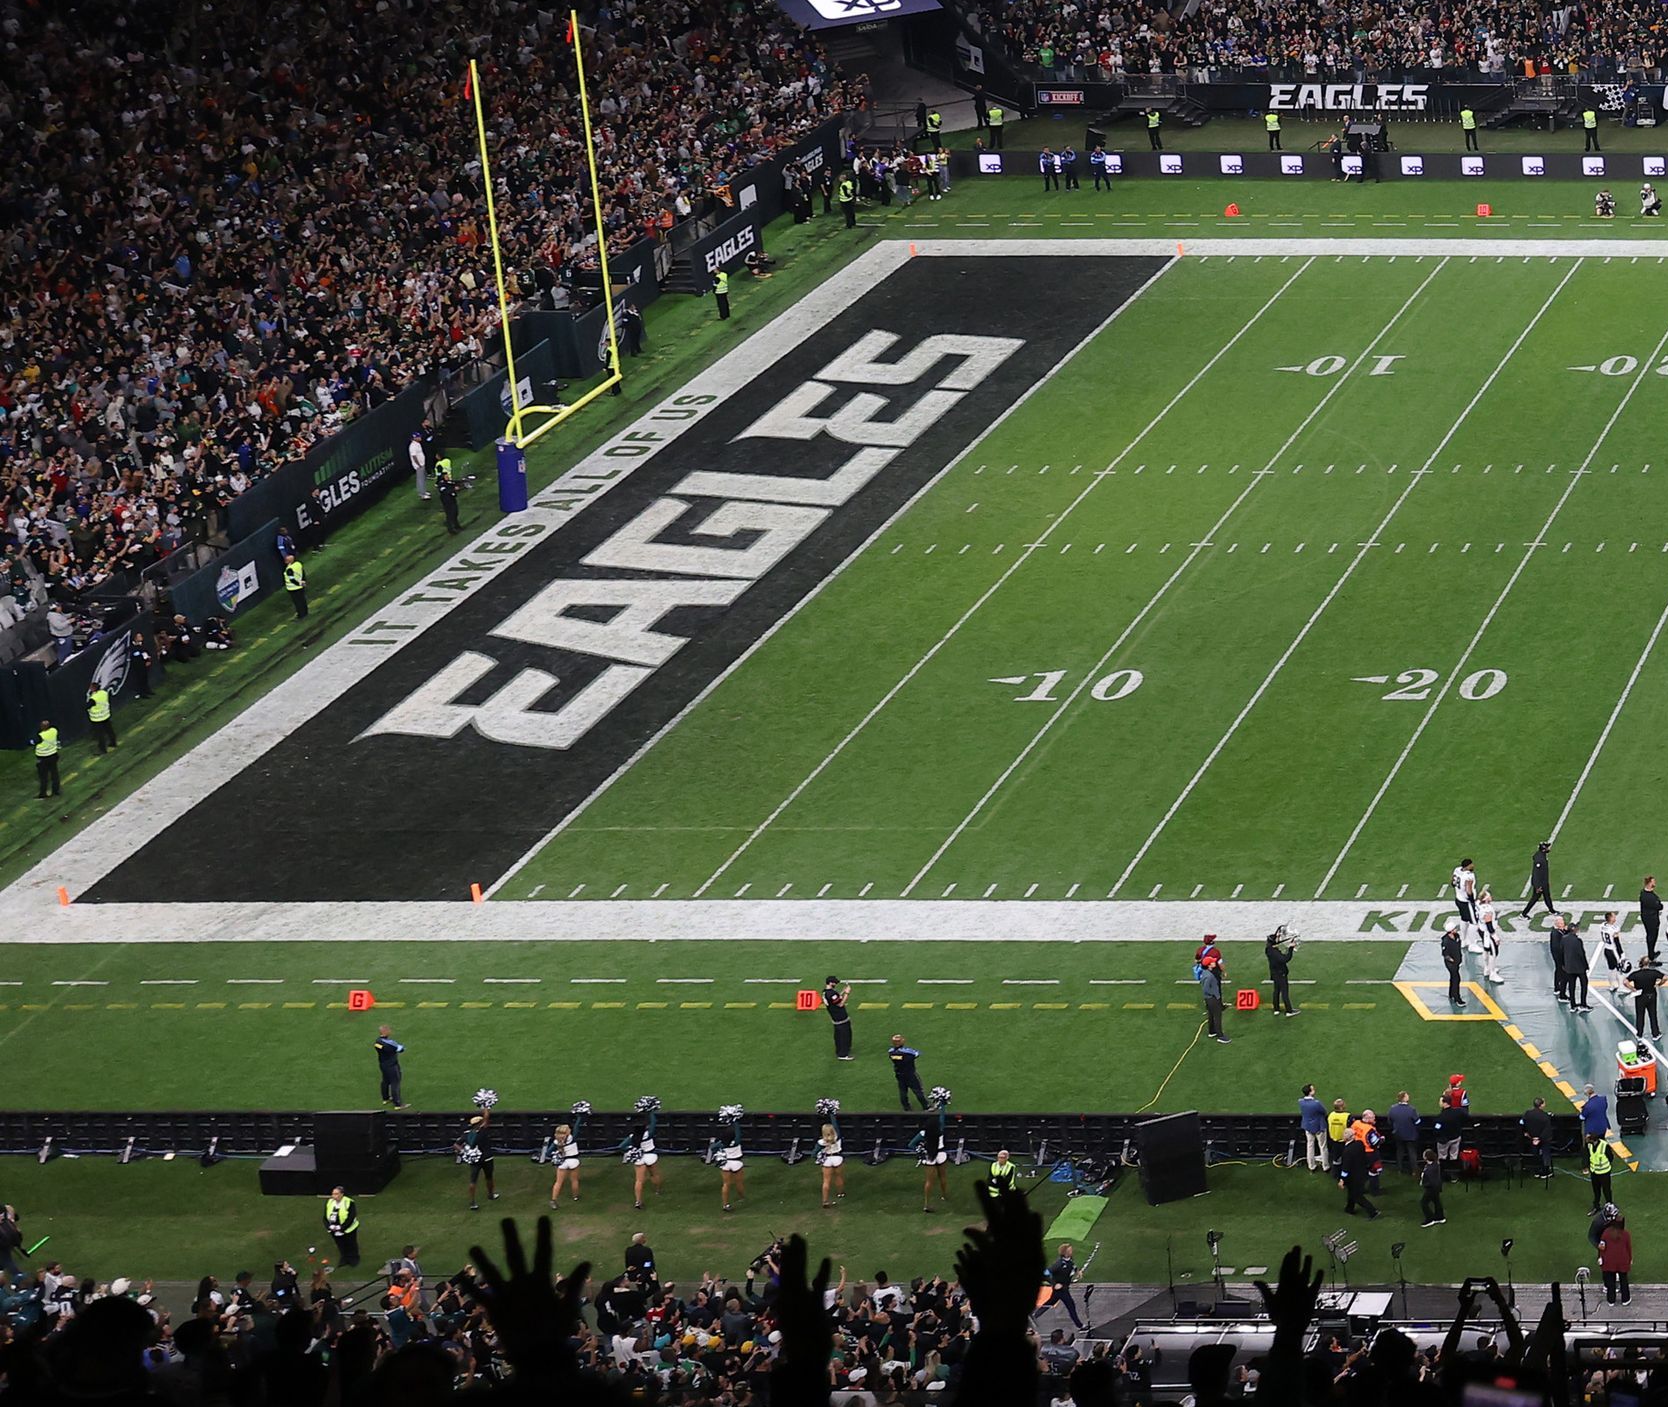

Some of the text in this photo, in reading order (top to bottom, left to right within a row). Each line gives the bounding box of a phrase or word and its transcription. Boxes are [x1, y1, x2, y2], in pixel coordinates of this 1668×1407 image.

[1052, 93, 1079, 102] KICKOFF
[1268, 84, 1429, 110] EAGLES
[704, 224, 756, 273] EAGLES
[1305, 355, 1405, 376] 10
[295, 448, 394, 530] EGLES AUTISM
[348, 390, 718, 648] IT TAKES ALL OF US
[349, 329, 1028, 750] EAGLES
[1013, 666, 1145, 702] 10
[1380, 666, 1509, 702] 20
[352, 992, 364, 1008] G
[799, 992, 813, 1008] 10
[1239, 991, 1253, 1007] 20
